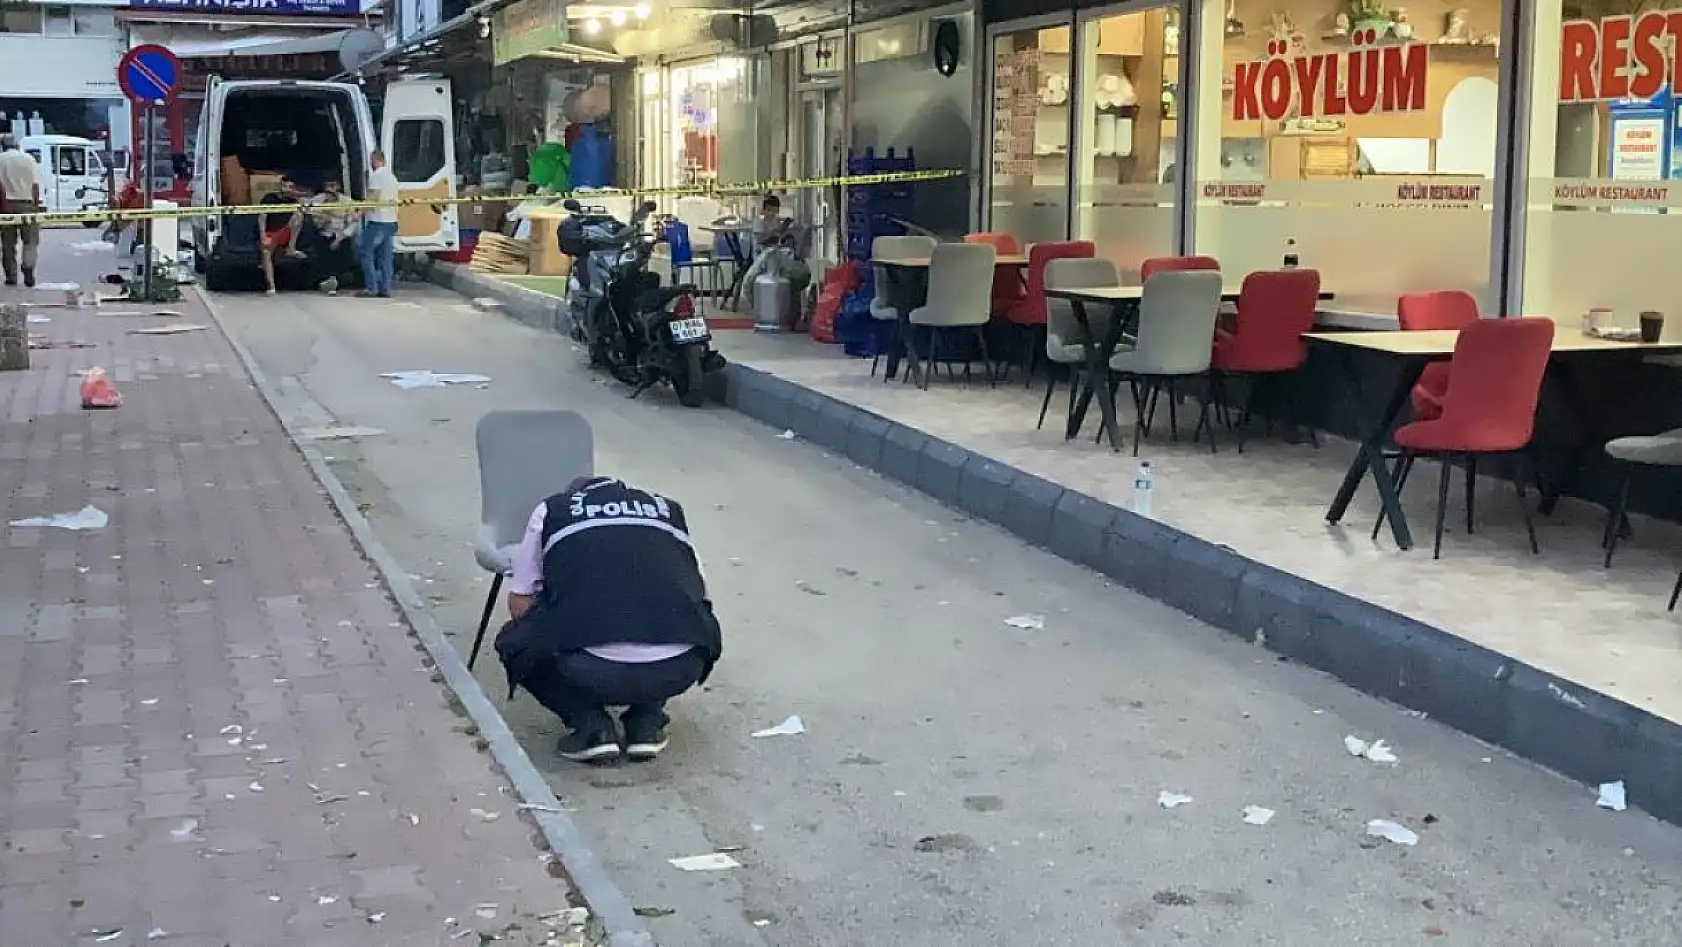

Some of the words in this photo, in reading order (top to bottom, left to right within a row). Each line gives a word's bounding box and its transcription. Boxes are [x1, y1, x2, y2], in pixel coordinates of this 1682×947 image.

[1232, 28, 1428, 121] KÖYLÜM
[1397, 182, 1428, 200] KÖYLÜM
[1429, 184, 1480, 200] RESTAURANT
[1554, 183, 1598, 198] KÖYLÜM
[1599, 186, 1668, 200] RESTAURANT
